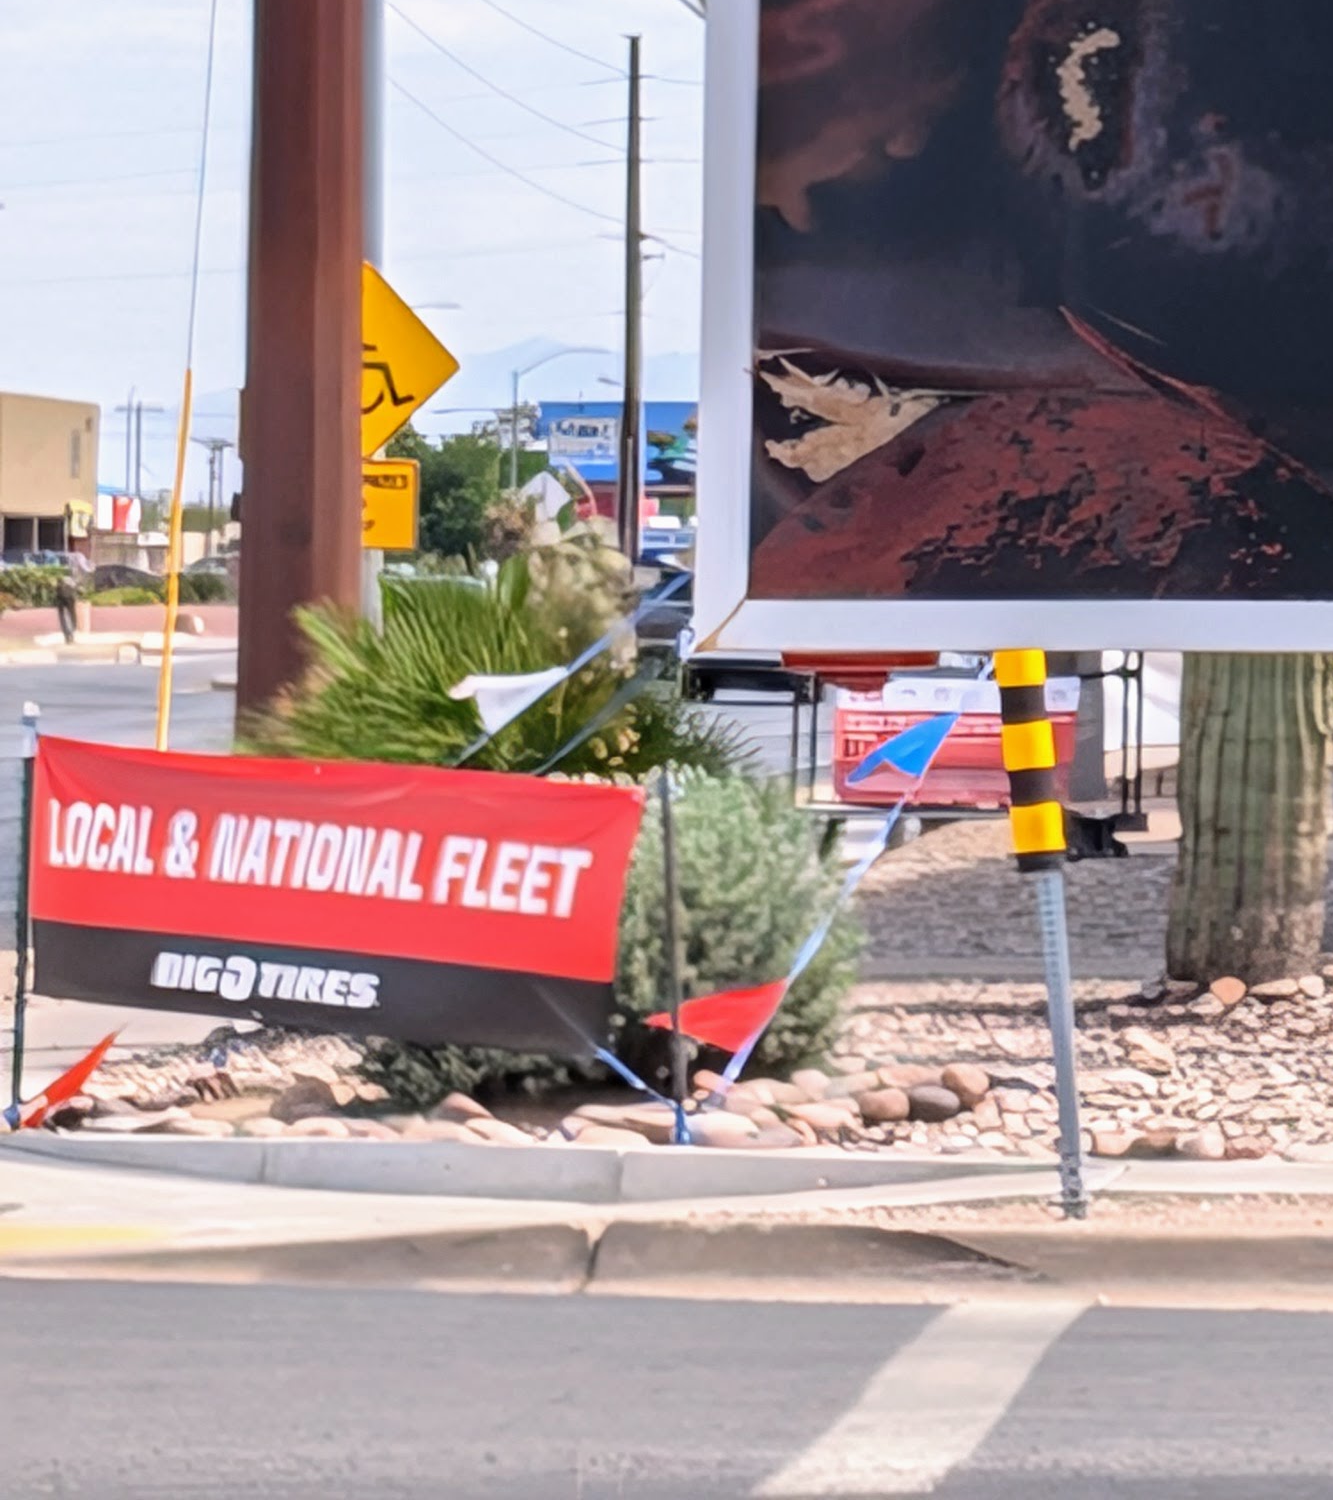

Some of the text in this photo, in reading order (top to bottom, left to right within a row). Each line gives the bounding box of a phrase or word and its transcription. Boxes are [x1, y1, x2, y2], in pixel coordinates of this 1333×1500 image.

[48, 798, 592, 918] LOCAL & NATIONAL FLEET
[258, 961, 379, 1008] TIRES
